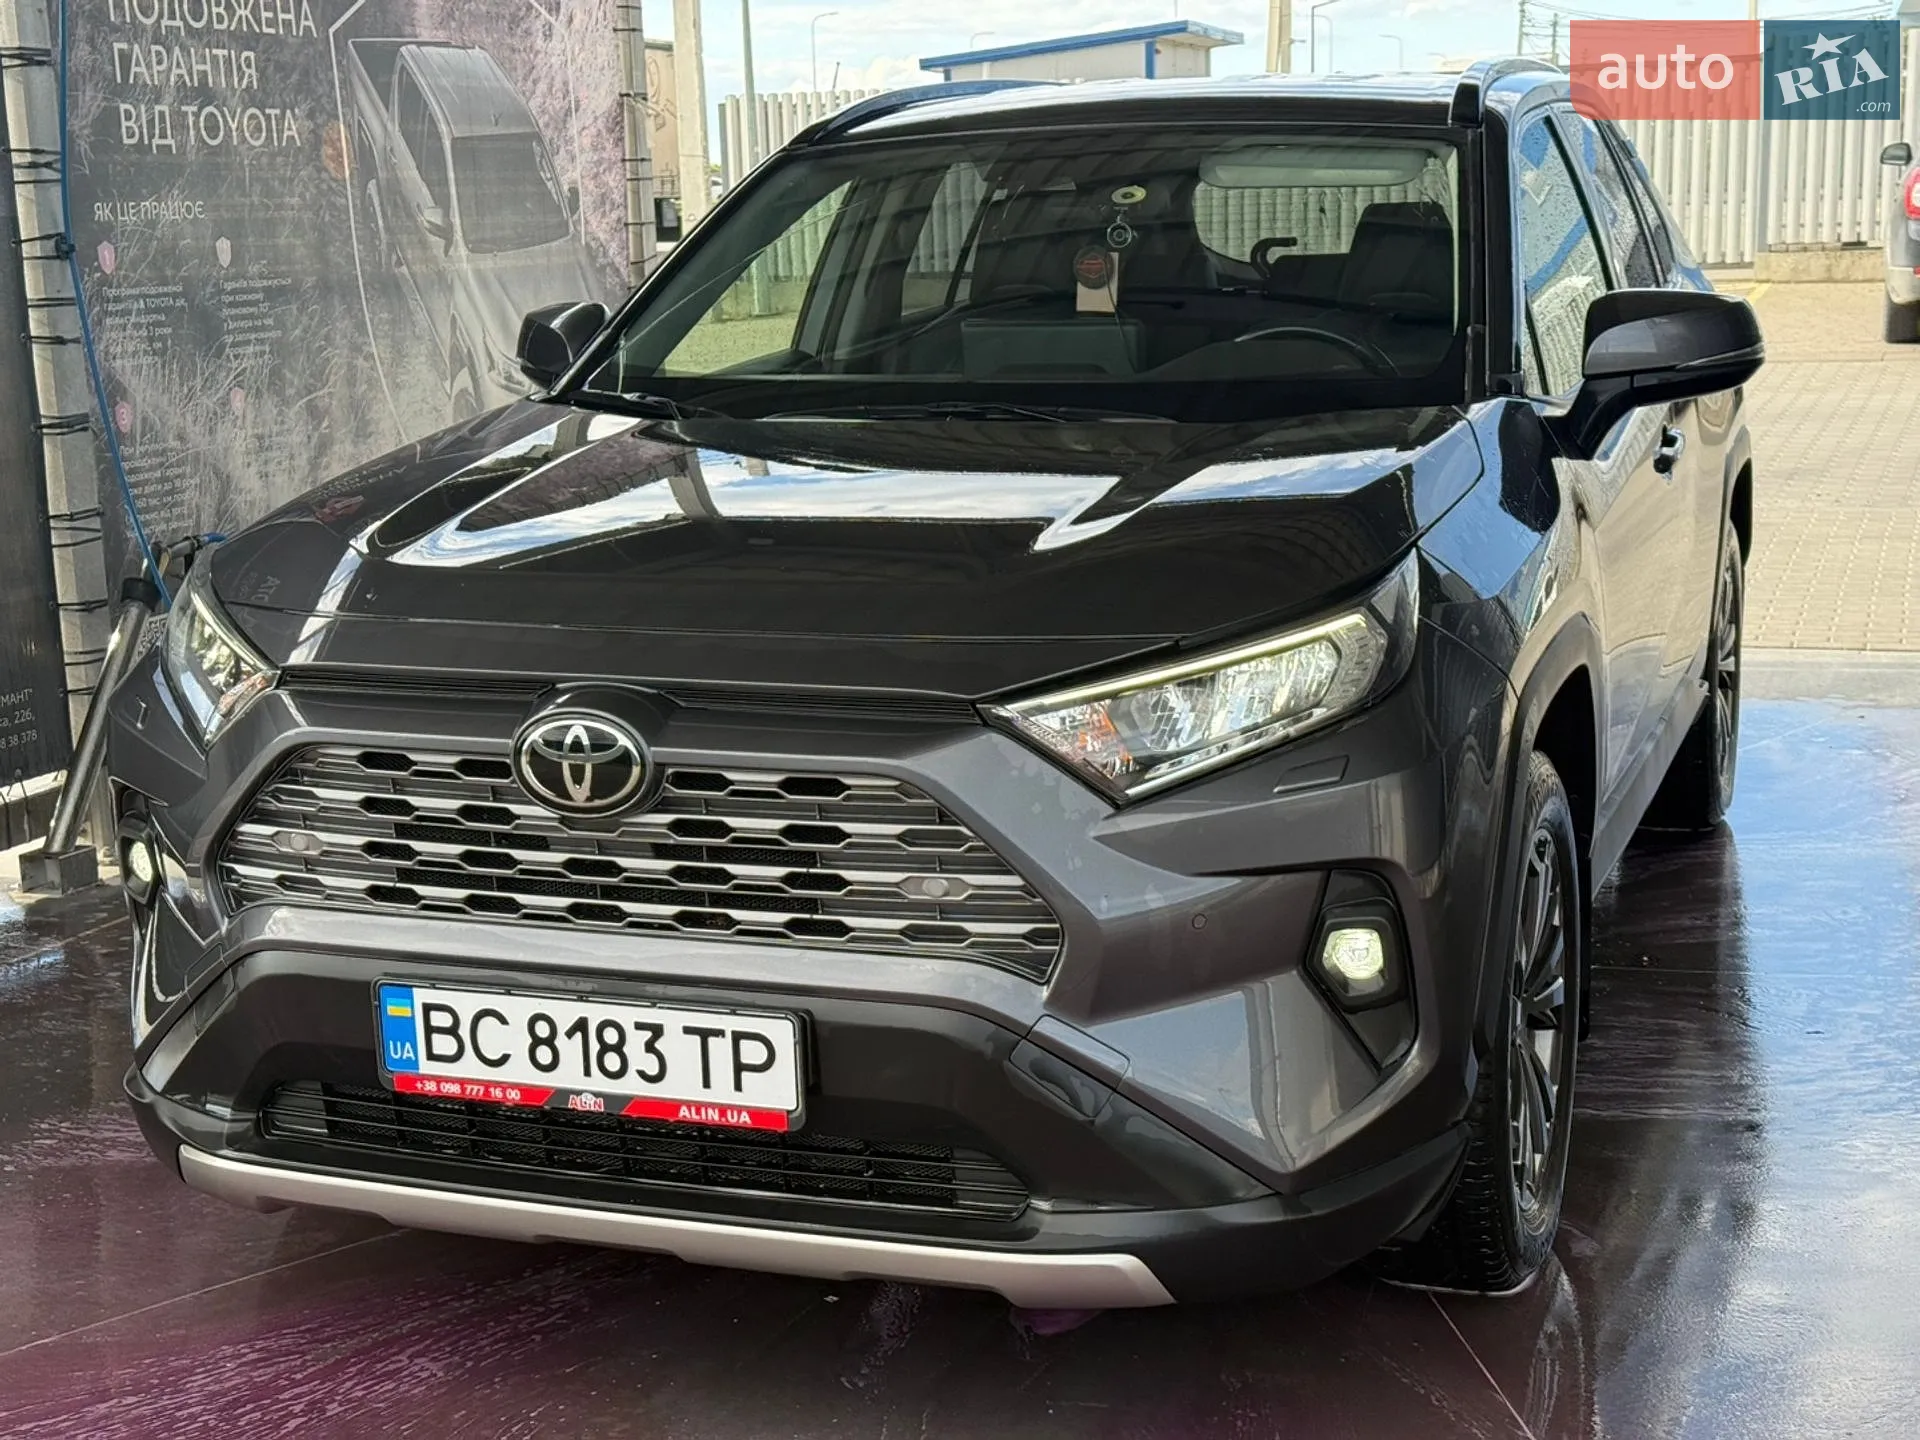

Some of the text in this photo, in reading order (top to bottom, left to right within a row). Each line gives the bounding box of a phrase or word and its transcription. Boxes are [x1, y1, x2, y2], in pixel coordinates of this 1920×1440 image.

[113, 42, 258, 90] ГАРАНТІЯ
[119, 103, 176, 154] ВІД
[94, 201, 206, 223] ЯК ЦЕ ПРАЦЮЄ
[14, 708, 36, 724] 226,
[8, 734, 19, 747] 38
[389, 1041, 415, 1060] UA
[421, 1002, 777, 1093] BC 8183 TP
[415, 1080, 520, 1100] +38 098 777 16 00
[568, 1092, 605, 1112] ALIN
[678, 1104, 752, 1124] ALIN.UA
